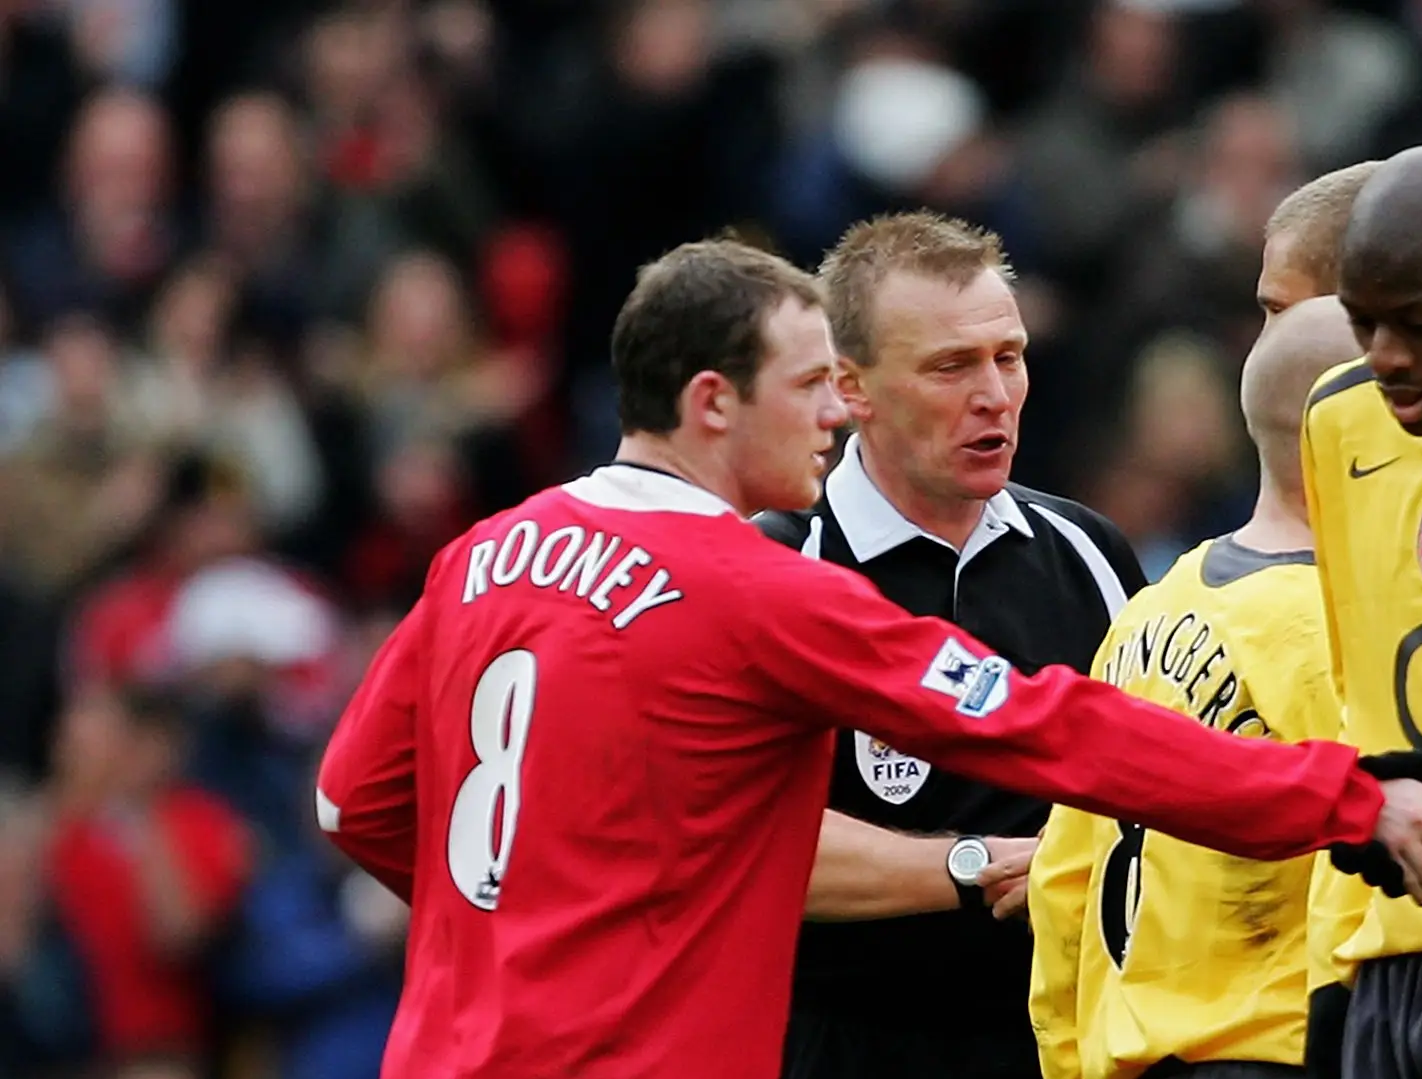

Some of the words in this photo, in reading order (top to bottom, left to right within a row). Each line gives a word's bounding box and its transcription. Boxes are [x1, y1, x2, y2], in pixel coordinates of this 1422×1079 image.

[461, 519, 684, 630] ROONEY
[448, 647, 538, 912] 8
[872, 761, 921, 781] FIFA
[883, 784, 912, 797] 2006
